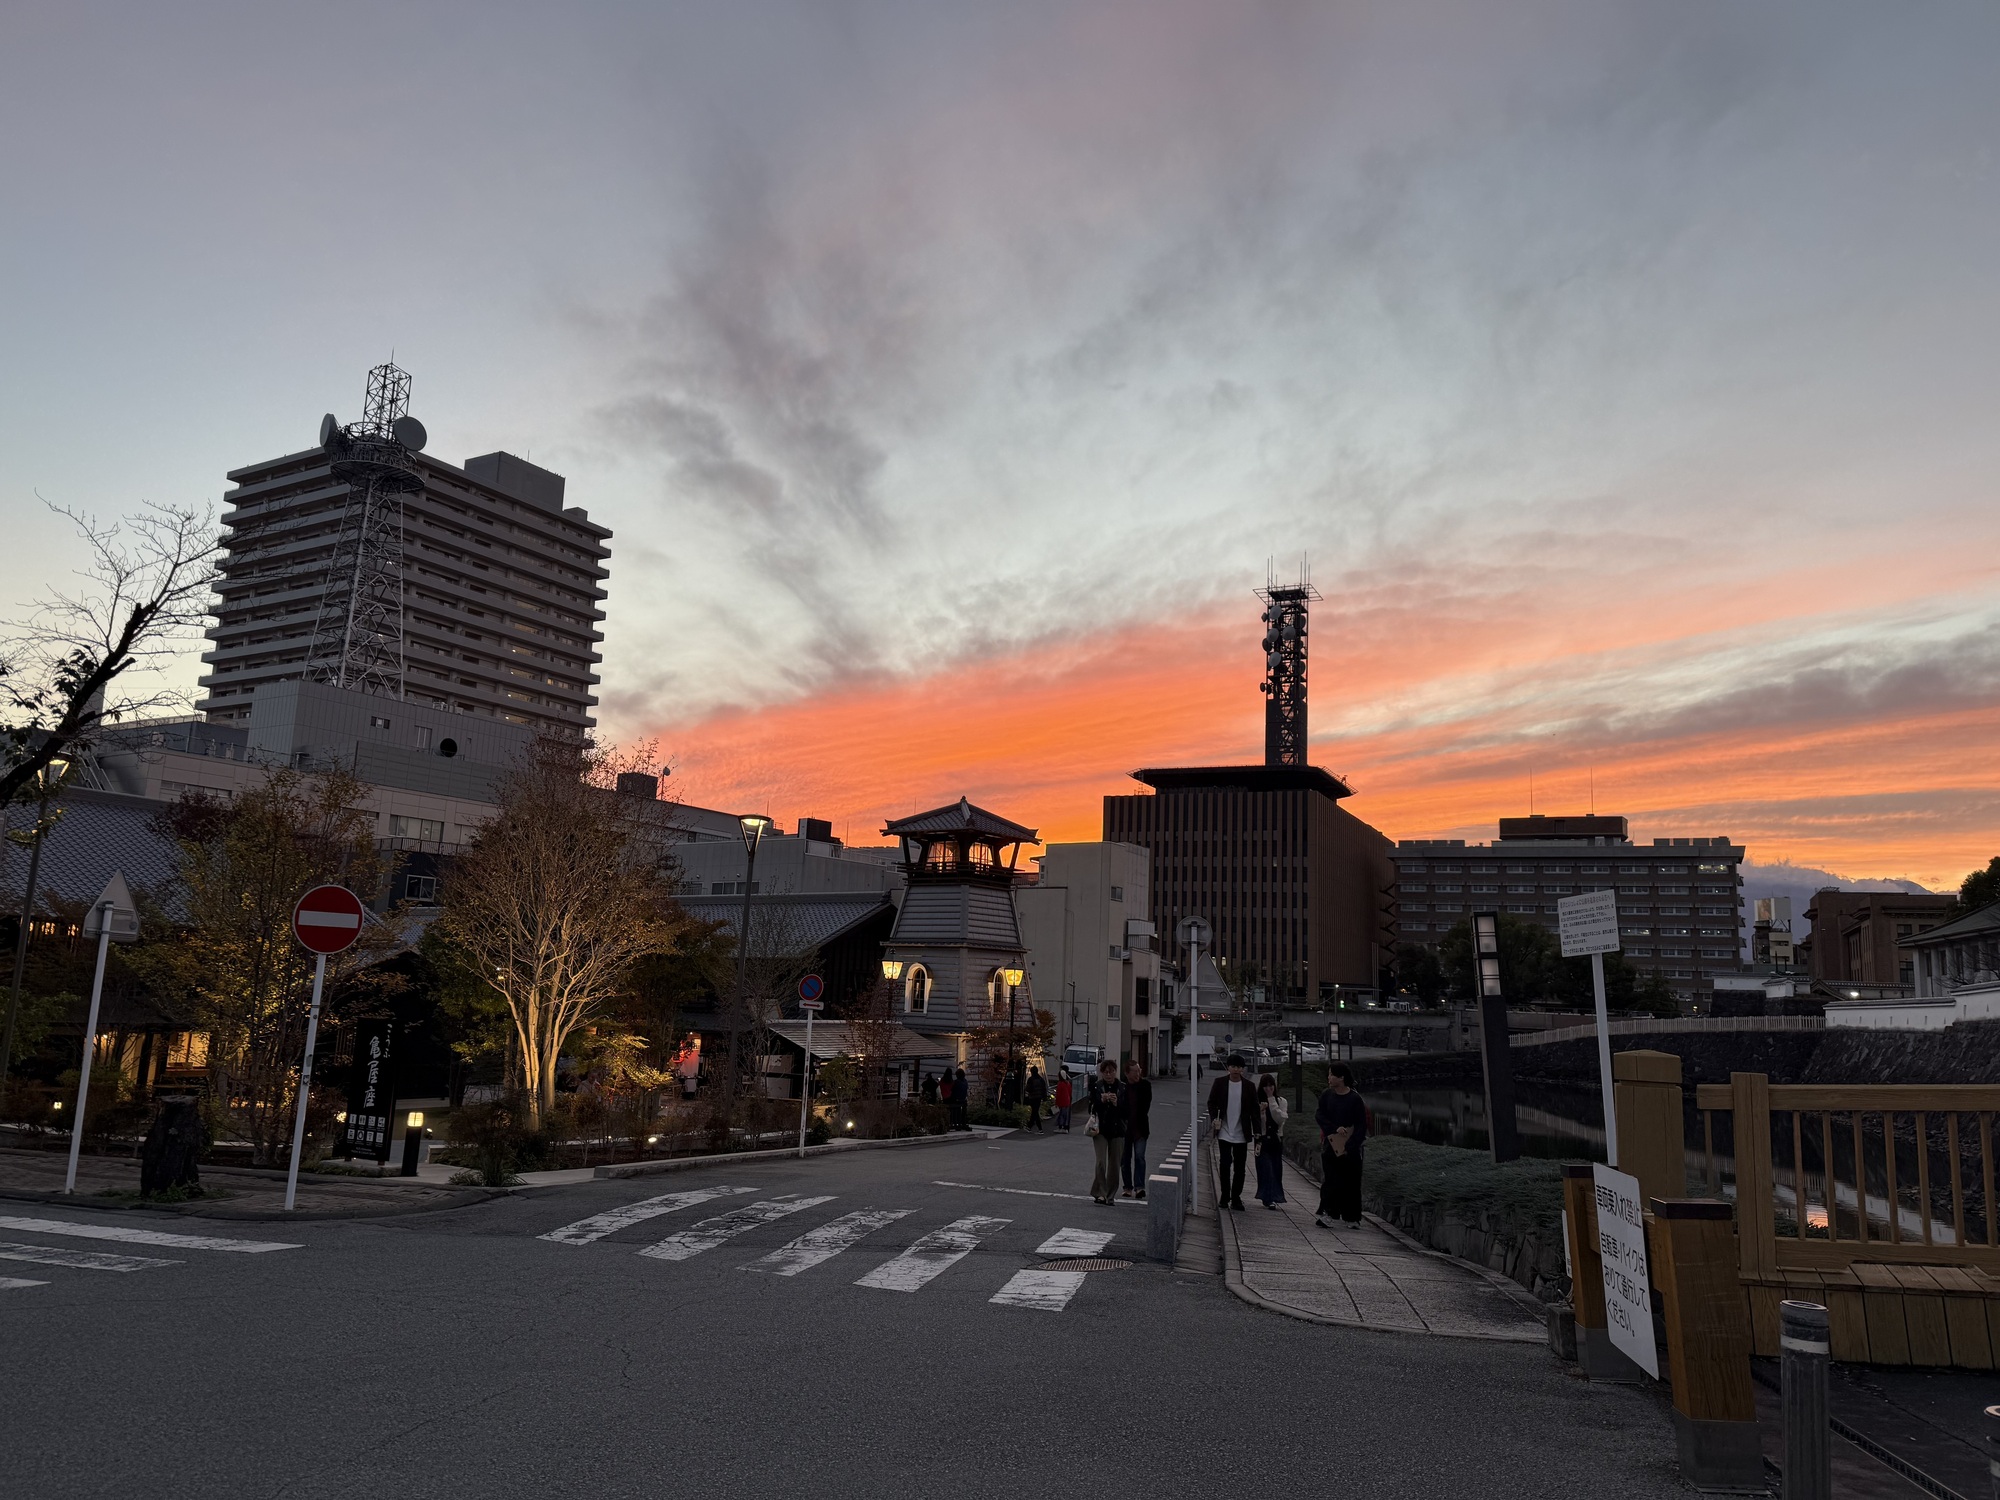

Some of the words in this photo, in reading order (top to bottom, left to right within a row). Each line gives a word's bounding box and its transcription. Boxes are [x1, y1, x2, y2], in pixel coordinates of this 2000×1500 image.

[383, 1023, 393, 1059] こうふ
[363, 1035, 381, 1109] 亀屋座
[1596, 1184, 1642, 1229] 車両乗入れ禁止
[1604, 1264, 1648, 1313] おりて通行して
[1607, 1298, 1636, 1338] ください。
